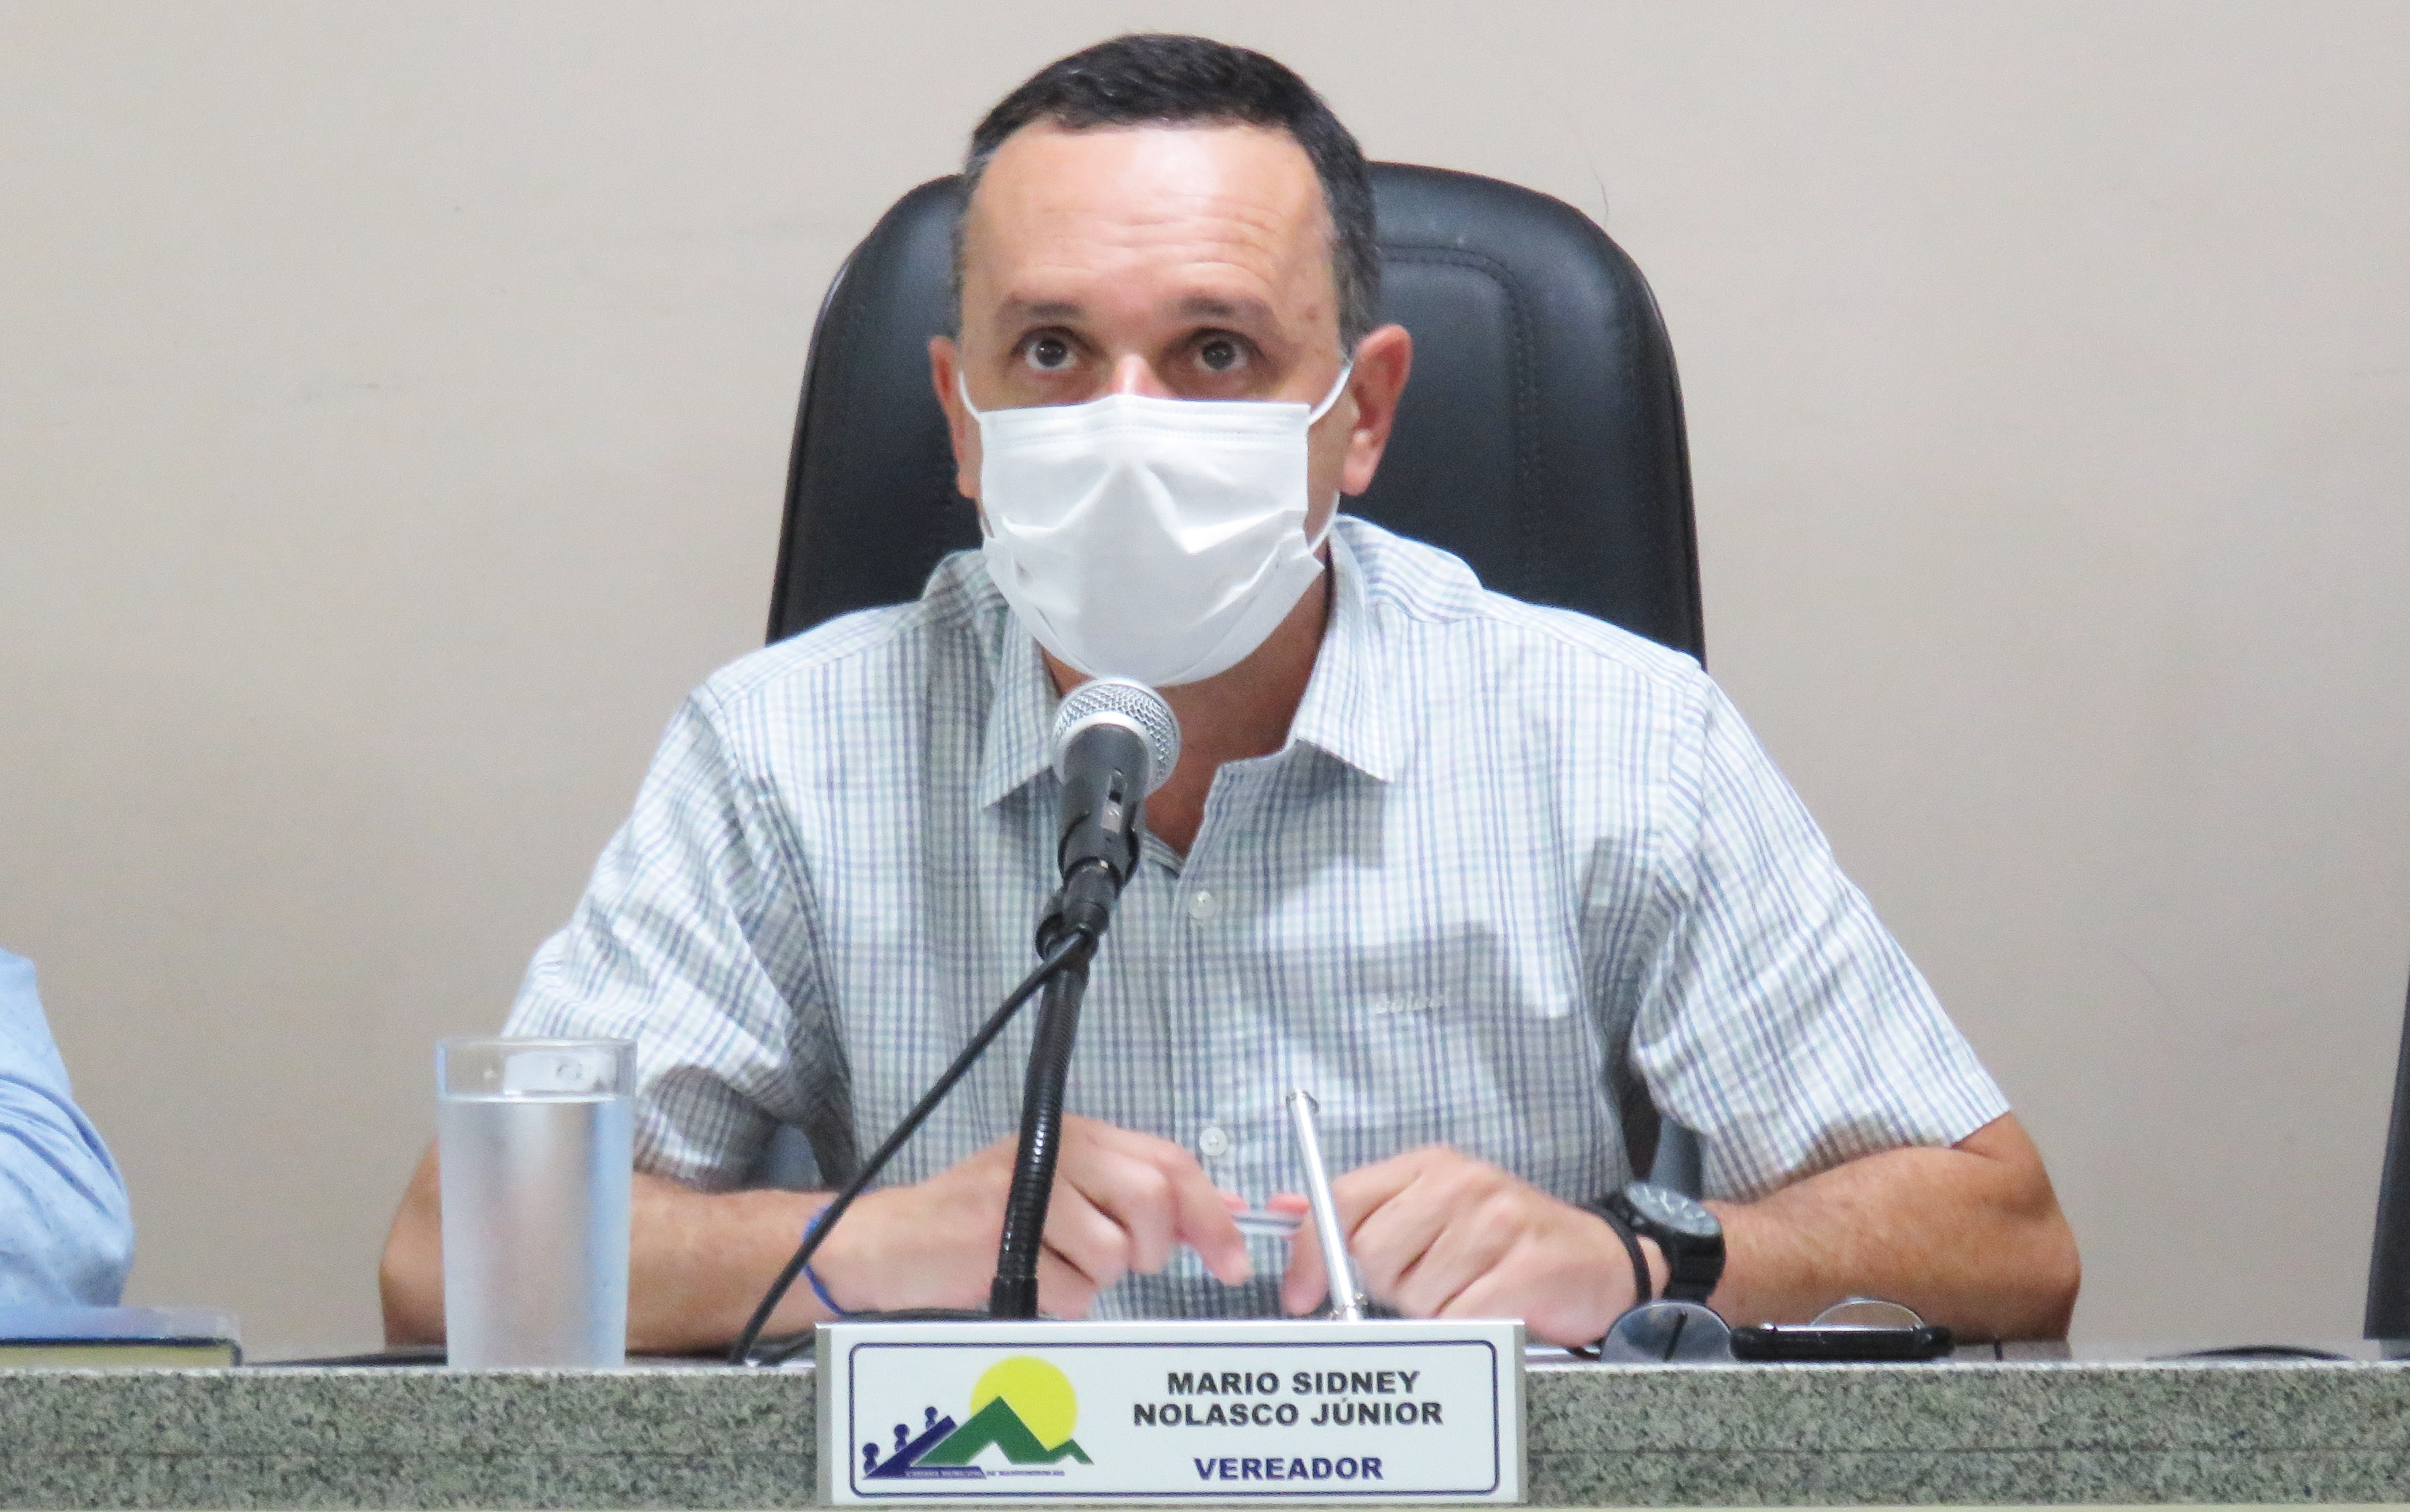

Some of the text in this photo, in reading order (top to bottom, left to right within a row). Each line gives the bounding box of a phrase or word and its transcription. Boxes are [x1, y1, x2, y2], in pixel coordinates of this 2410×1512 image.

[1167, 1371, 1420, 1395] MARIO SIDNEY
[1133, 1397, 1442, 1426] NOLASCO JÚNIOR
[1194, 1457, 1383, 1481] VEREADOR
